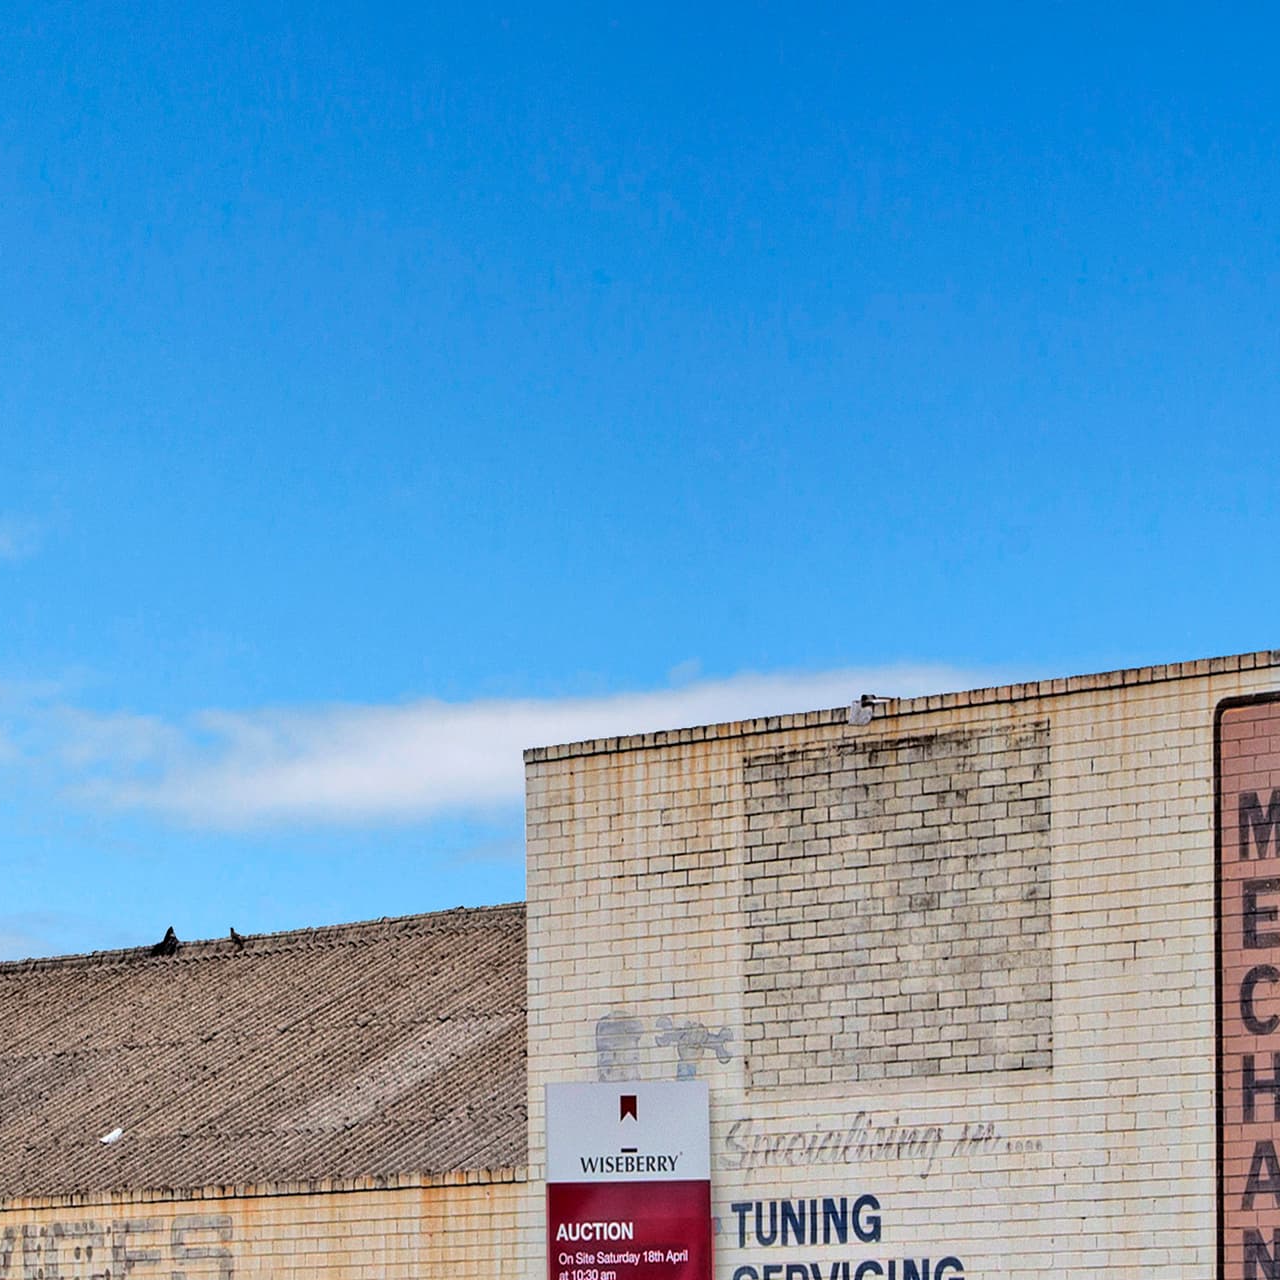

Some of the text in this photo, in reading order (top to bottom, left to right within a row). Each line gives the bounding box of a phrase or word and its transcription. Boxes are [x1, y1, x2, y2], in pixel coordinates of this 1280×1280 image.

[581, 1155, 679, 1174] WISEBERRY
[731, 1194, 882, 1248] TUNING
[556, 1222, 634, 1242] AUCTION
[558, 1249, 689, 1267] On Site Saturday 18th April
[600, 1270, 617, 1280] am
